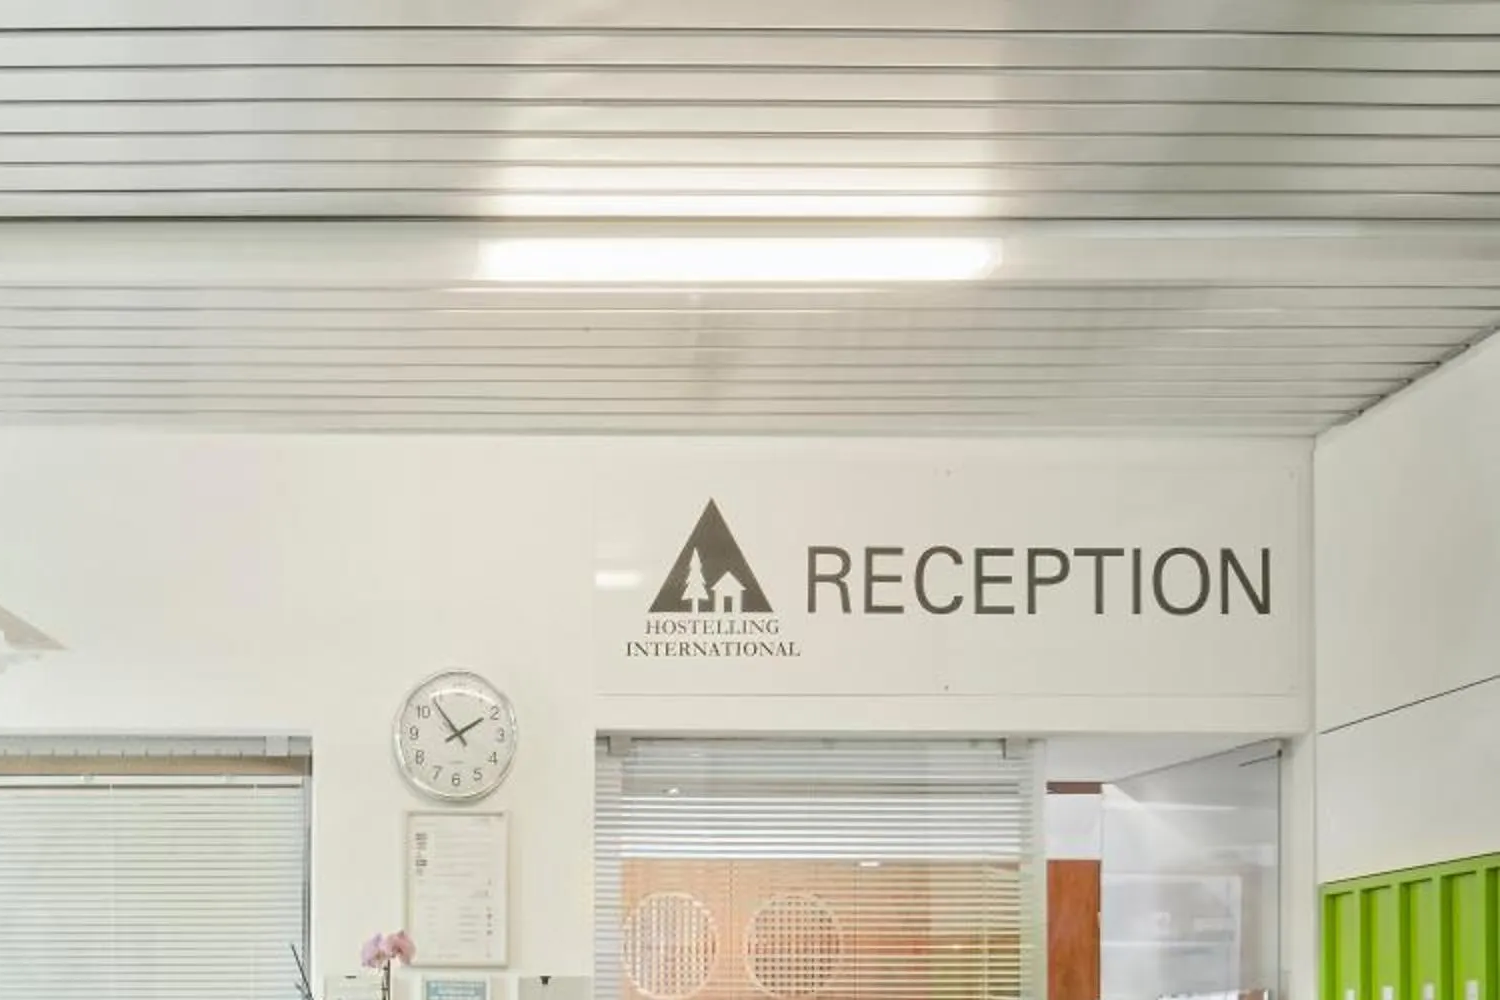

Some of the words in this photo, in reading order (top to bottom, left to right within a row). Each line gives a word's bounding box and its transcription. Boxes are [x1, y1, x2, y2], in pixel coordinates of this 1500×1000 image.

[806, 546, 1271, 615] RECEPTION
[644, 619, 780, 636] HOSTELLING
[625, 641, 801, 658] INTERNATIONAL
[417, 705, 431, 719] 10
[490, 706, 500, 721] 2
[409, 725, 419, 740] 9
[496, 728, 505, 743] 3
[488, 752, 498, 765] 4
[433, 765, 443, 780] 7
[451, 773, 461, 787] 6
[473, 768, 483, 781] 5
